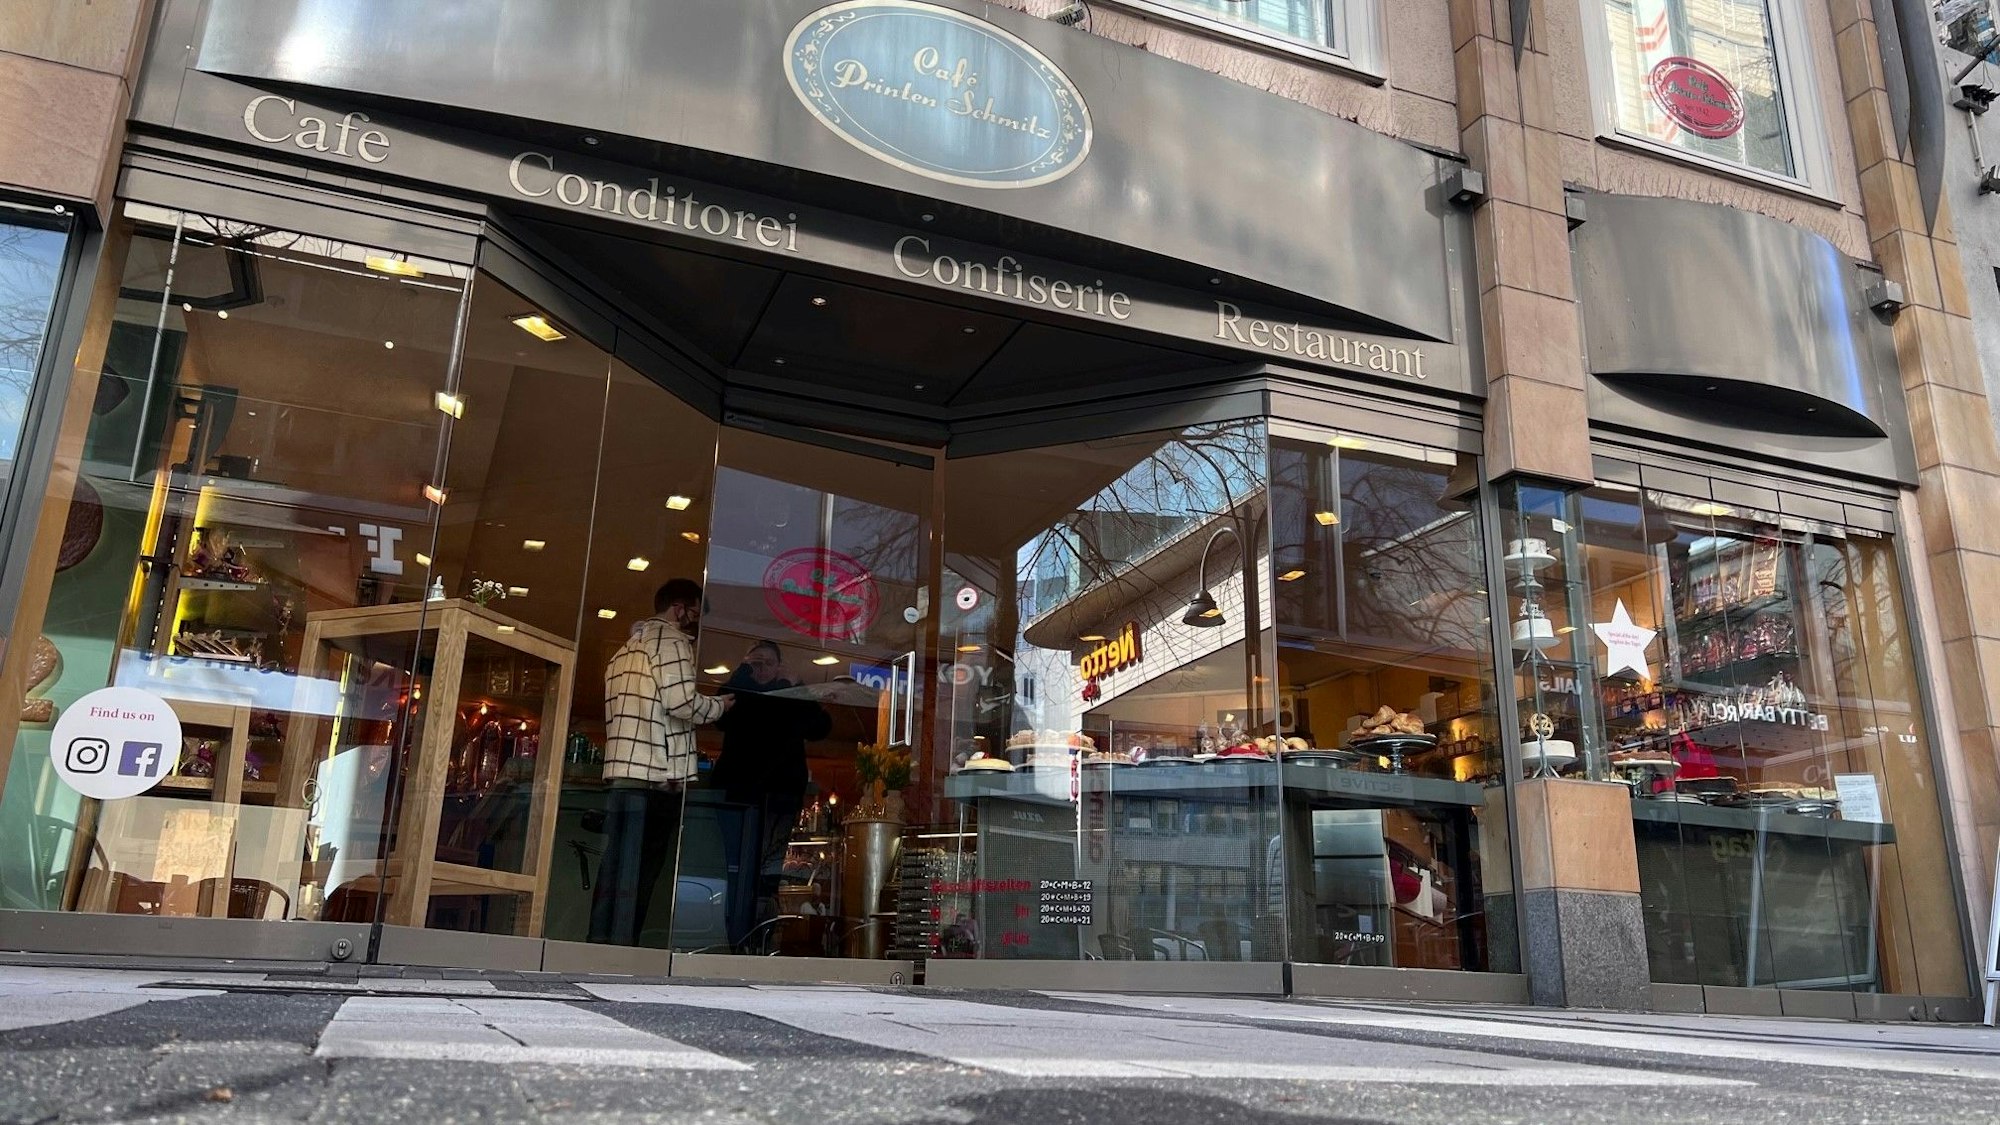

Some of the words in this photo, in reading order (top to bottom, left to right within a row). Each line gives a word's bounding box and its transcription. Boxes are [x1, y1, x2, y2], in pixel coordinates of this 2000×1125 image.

[913, 46, 977, 88] Café
[830, 59, 937, 108] Printen
[945, 90, 1051, 139] Schmitz
[244, 95, 390, 163] Cafe
[508, 151, 800, 253] Conditorei
[893, 235, 1132, 320] Confiserie
[1214, 300, 1428, 380] Restaurant
[90, 706, 119, 718] Find
[122, 711, 136, 720] us
[139, 712, 155, 721] on
